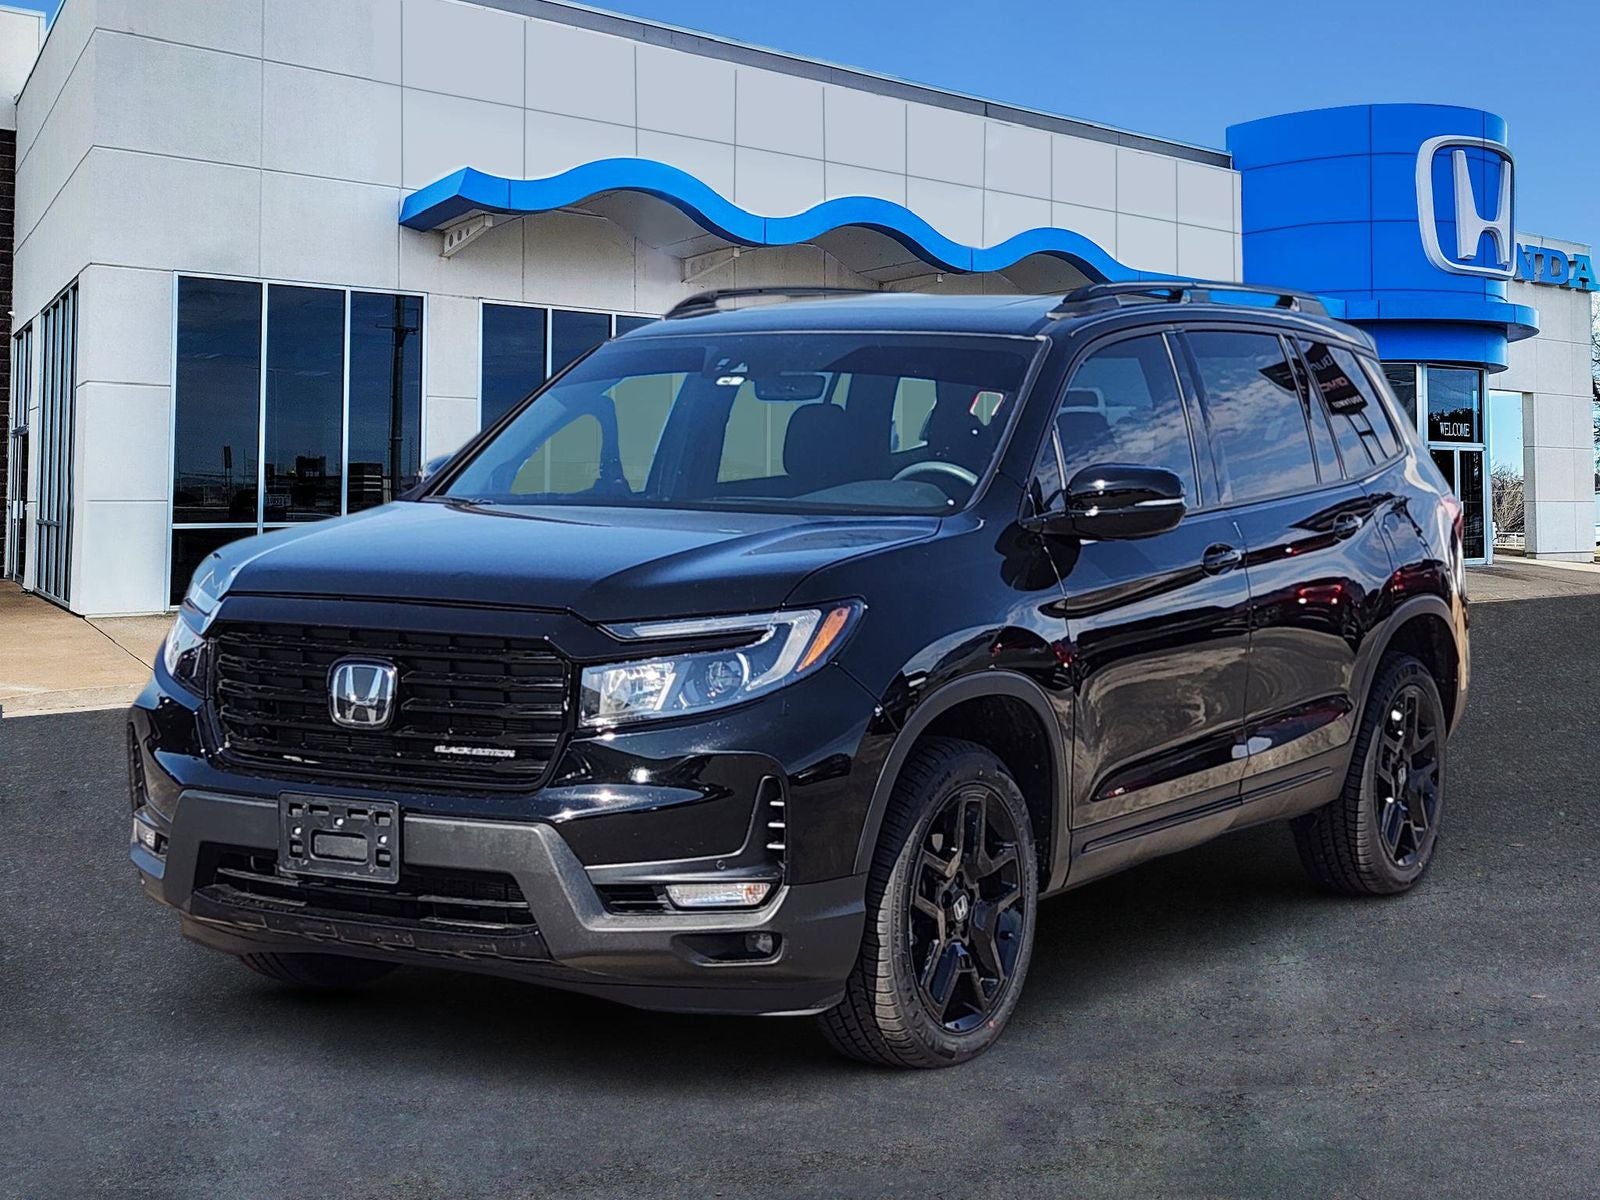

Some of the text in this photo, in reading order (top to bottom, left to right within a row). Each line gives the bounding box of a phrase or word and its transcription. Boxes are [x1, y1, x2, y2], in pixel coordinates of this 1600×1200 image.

[1513, 243, 1600, 292] NDA
[1440, 422, 1470, 437] WELCOME
[434, 745, 516, 758] BLACK EDITION
